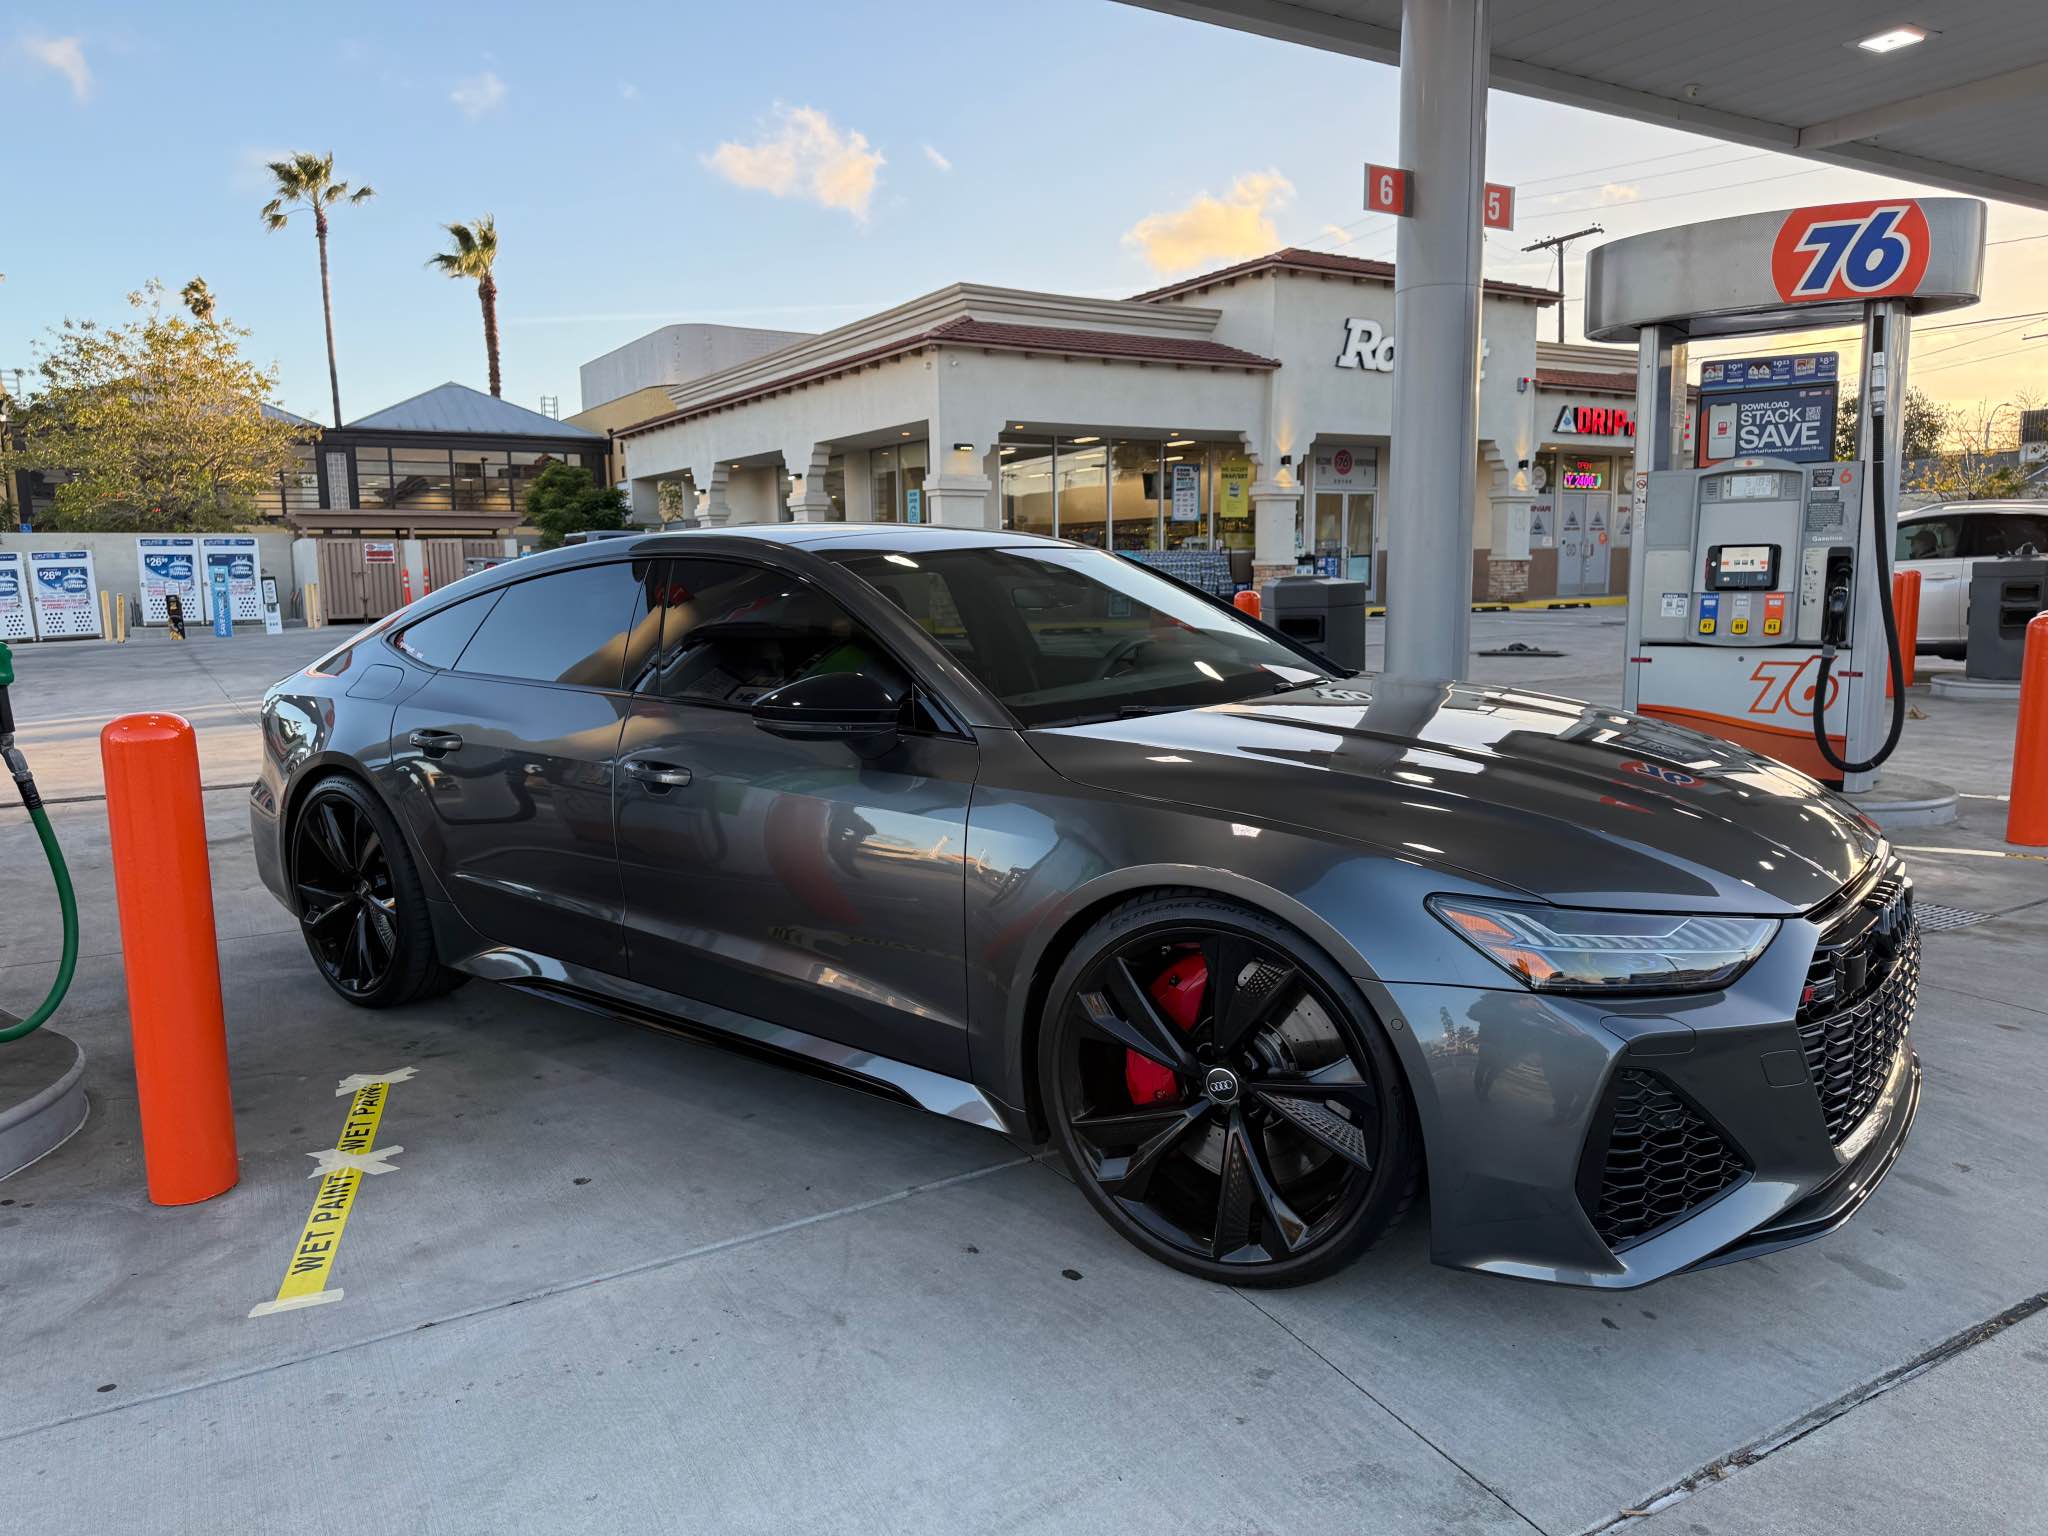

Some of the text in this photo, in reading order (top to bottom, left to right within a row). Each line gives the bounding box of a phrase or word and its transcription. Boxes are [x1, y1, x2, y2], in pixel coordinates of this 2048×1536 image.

[1379, 174, 1393, 205] 6
[1488, 191, 1501, 220] 5
[1792, 206, 1910, 296] 76
[1741, 400, 1790, 411] DOWNLOAD
[1741, 407, 1802, 426] STACK
[1577, 406, 1628, 436] DRIP
[1739, 421, 1820, 449] SAVE
[1840, 468, 1852, 484] 6
[1749, 655, 1840, 717] 76
[340, 1121, 373, 1152] WET
[291, 1175, 355, 1275] WET PAINT
